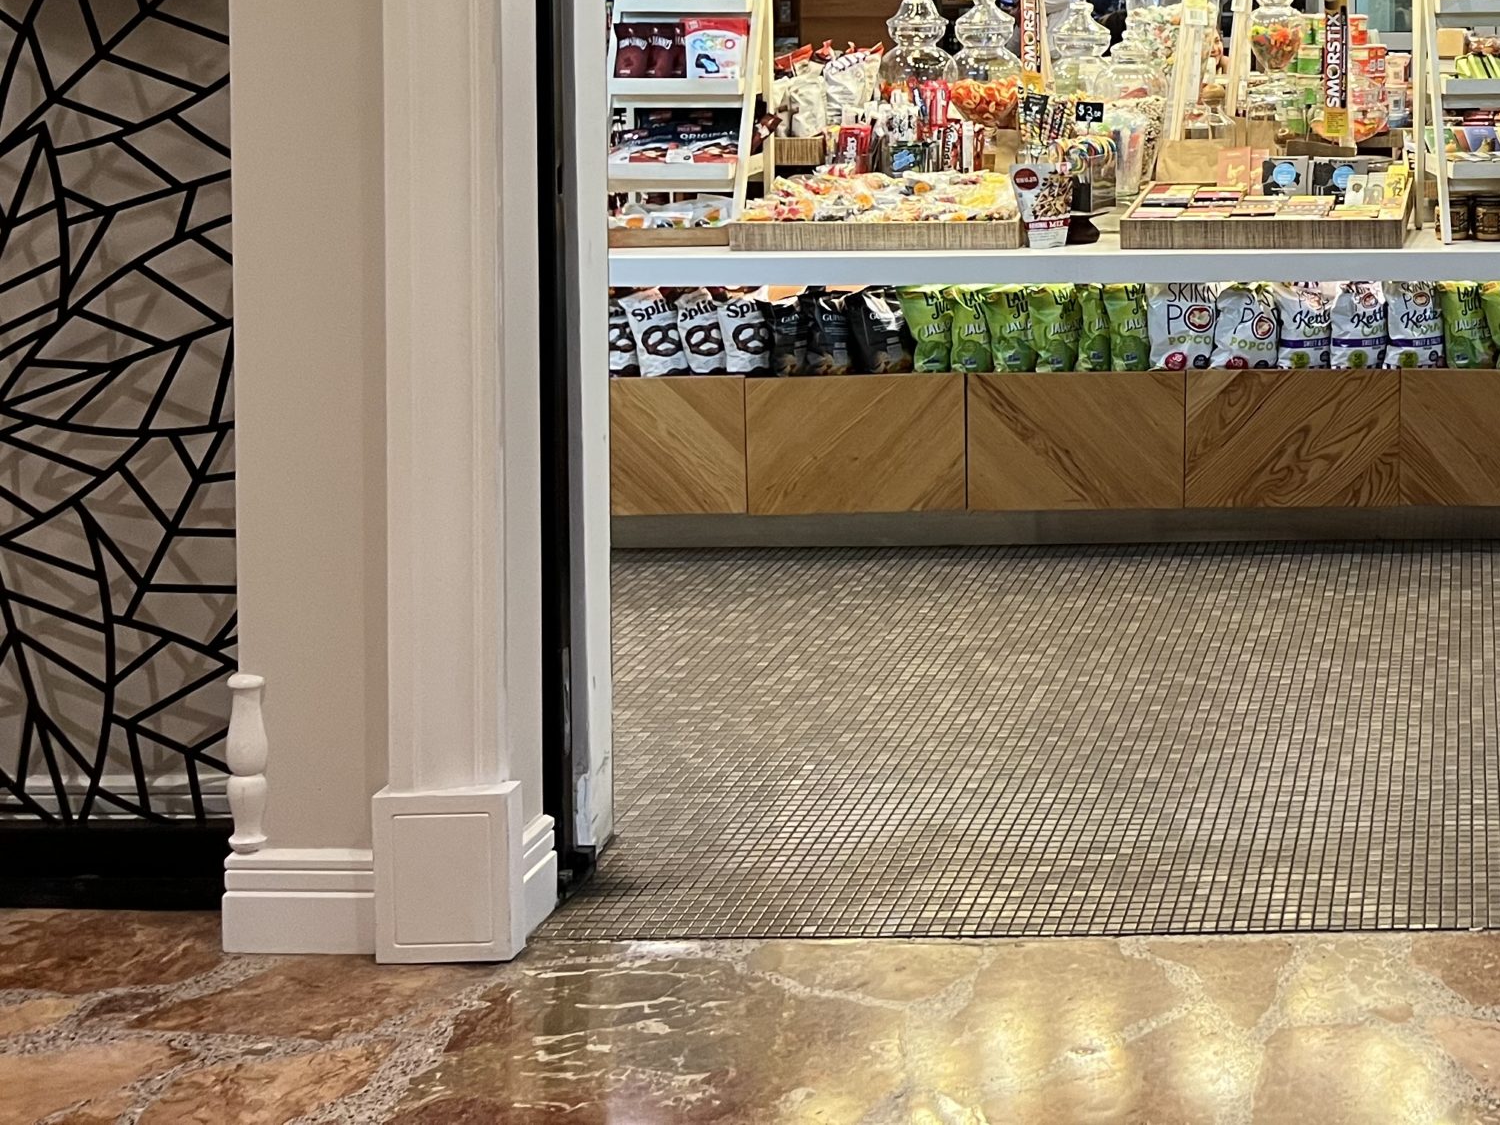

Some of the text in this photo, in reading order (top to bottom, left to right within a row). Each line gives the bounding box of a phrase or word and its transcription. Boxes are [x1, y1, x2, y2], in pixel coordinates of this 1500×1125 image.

[1167, 282, 1218, 302] SKINN
[631, 298, 672, 322] Split
[1168, 335, 1212, 345] POPCO
[1230, 337, 1274, 351] POPCO
